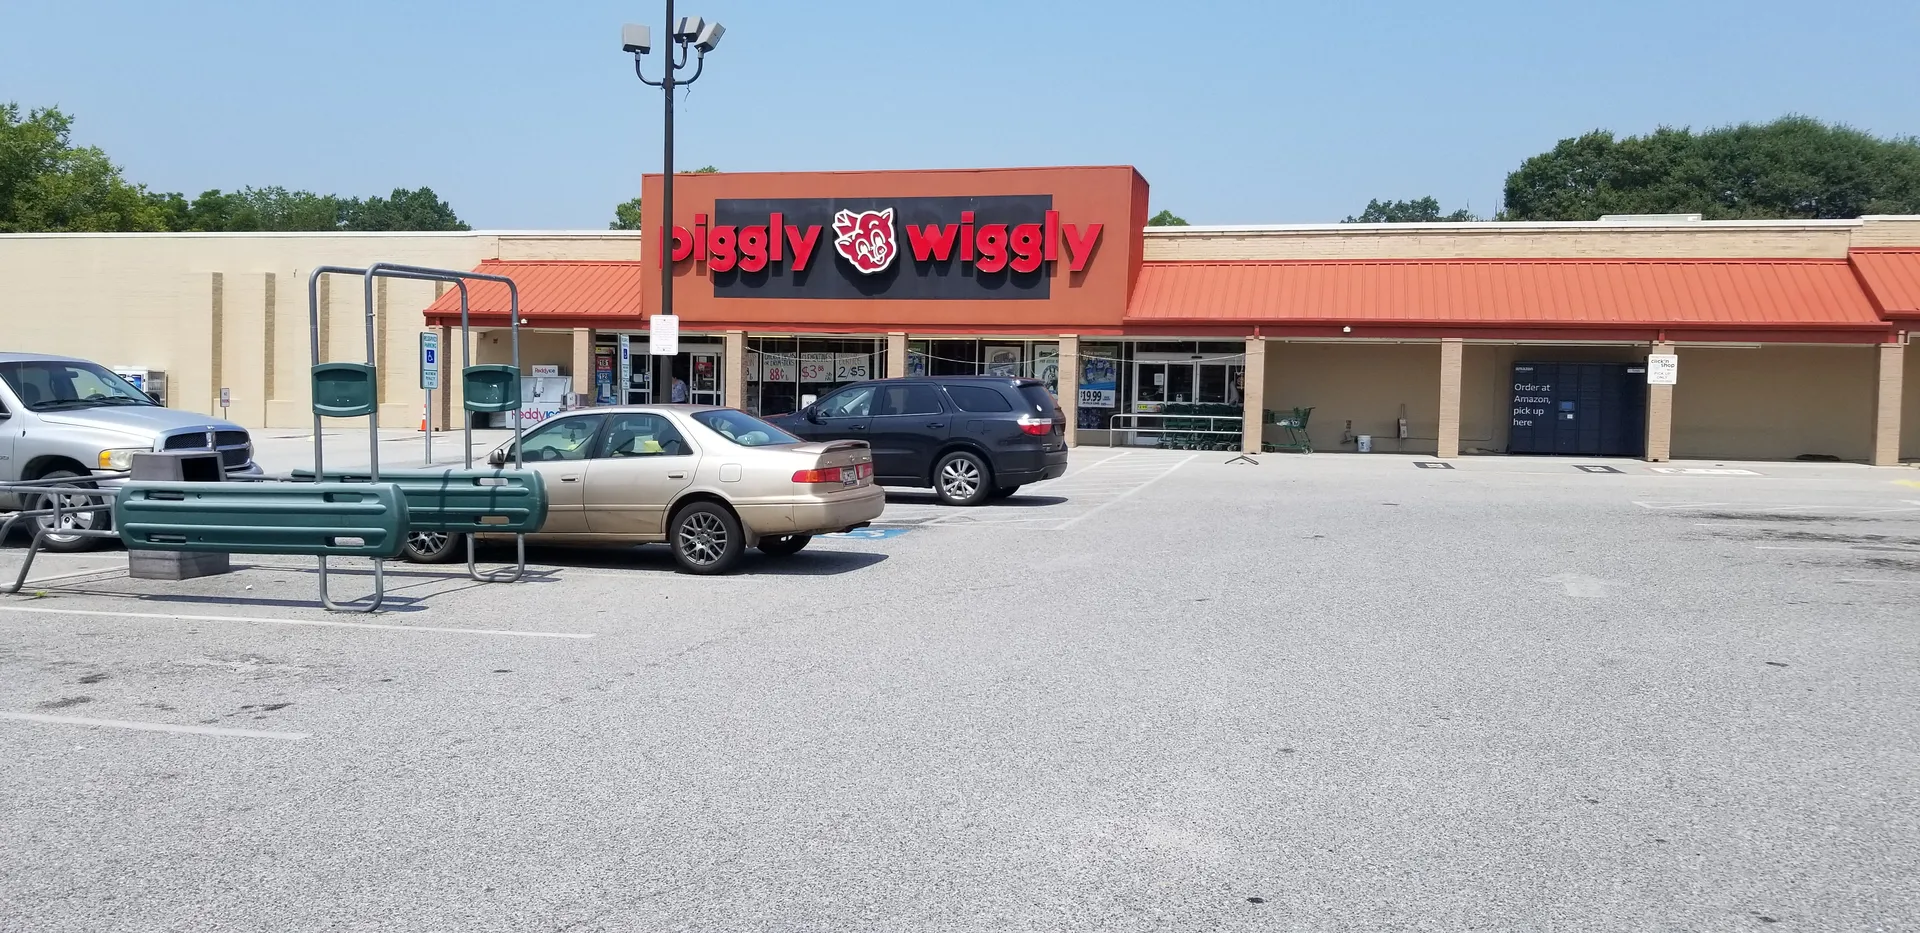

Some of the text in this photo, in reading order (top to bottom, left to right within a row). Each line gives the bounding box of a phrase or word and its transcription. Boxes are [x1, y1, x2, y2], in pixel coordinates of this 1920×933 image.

[659, 210, 1104, 273] piggly wiggly
[837, 365, 866, 380] 2/$5
[1514, 383, 1540, 391] Order
[1514, 395, 1551, 404] Amazon,
[1513, 407, 1544, 417] pick up
[1513, 418, 1533, 426] here
